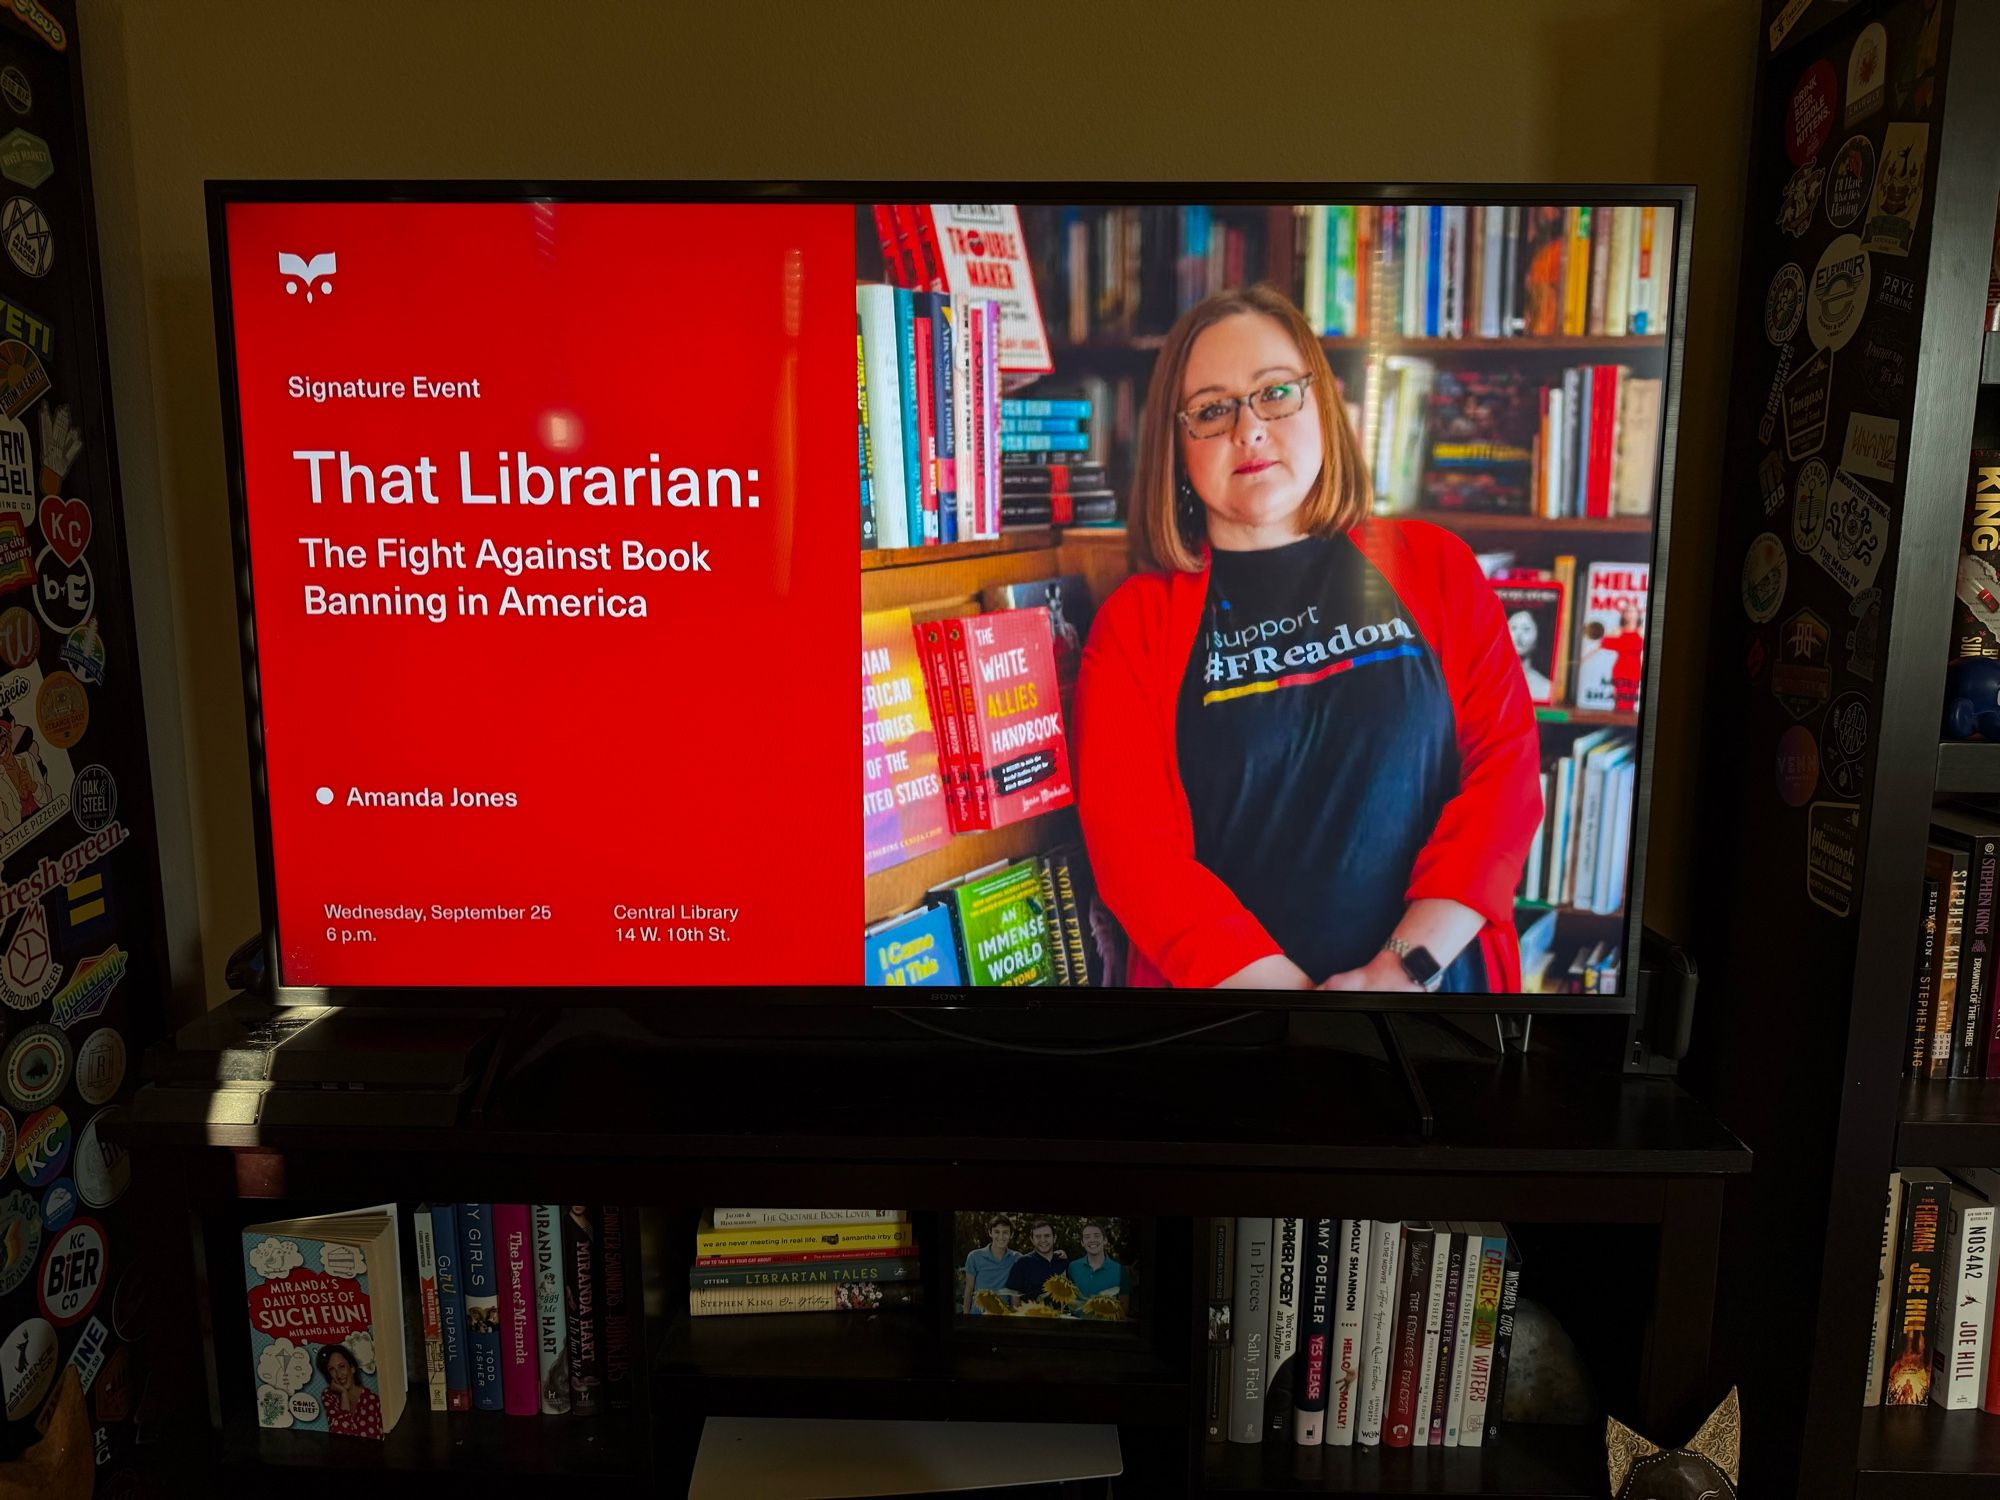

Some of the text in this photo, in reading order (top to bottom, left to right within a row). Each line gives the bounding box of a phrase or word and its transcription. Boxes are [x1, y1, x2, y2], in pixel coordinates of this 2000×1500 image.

[1794, 75, 1817, 108] DRINK
[1796, 94, 1825, 133] CUDDLE
[12, 240, 35, 265] MADER
[14, 233, 37, 257] ALMA
[966, 260, 1015, 289] MAKER
[1816, 254, 1865, 288] ELEVATOR
[289, 377, 480, 402] Signature Event
[942, 323, 955, 454] Ancestor Trouble
[975, 339, 985, 477] POWER HUNGRY
[293, 451, 759, 507] That Librarian:
[1800, 465, 1826, 488] VICTORIA
[1764, 483, 1785, 516] ZOO
[299, 538, 711, 576] The Fight Against Book
[1832, 559, 1851, 580] MARK
[305, 586, 646, 622] Banning in America
[975, 627, 995, 647] THE
[1213, 605, 1319, 648] support
[979, 648, 1029, 683] WHITE
[987, 682, 1039, 719] ALLIES
[991, 712, 1062, 755] HANDBOOK
[867, 750, 909, 780] OF THE
[83, 781, 99, 795] OAK
[83, 797, 108, 813] STEEL
[347, 787, 517, 806] Amanda Jones
[896, 774, 940, 805] STATES
[5, 799, 66, 850] STYLE PIZZERIA
[325, 905, 551, 923] Wednesday, September 25
[615, 905, 739, 923] Central Library
[1001, 907, 1017, 924] AN
[1058, 866, 1089, 986] NORA EPHRON
[1942, 870, 1968, 980] STEPHEN KING
[327, 928, 375, 945] 6 p.m.
[617, 927, 730, 941] 14 W. 10th St.
[978, 913, 1046, 962] IMMENSE
[988, 942, 1043, 982] WORLD
[1964, 858, 1996, 1047] STEPHEN KING DRAWING OF THE THREE
[42, 965, 61, 997] BEER
[57, 954, 120, 1020] BOULEVARD
[931, 993, 967, 1001] SONY
[1912, 891, 1938, 1067] ELEVATION STEPHEN KING
[20, 1113, 56, 1152] MADE IN
[26, 1128, 63, 1178] KC
[70, 1233, 85, 1249] KC
[468, 1228, 484, 1286] GIRLS
[750, 1238, 779, 1247] meeting
[841, 1234, 876, 1242] samantha
[877, 1233, 891, 1242] irby
[745, 1271, 828, 1285] LIBRARIAN
[833, 1268, 878, 1280] TALES
[1346, 1218, 1362, 1311] MOLLY SHANNON
[1903, 1204, 1939, 1336] FIREMAN JOE HILL
[62, 1293, 78, 1310] CO
[263, 1291, 355, 1309] DAILY DOSE OF
[270, 1279, 340, 1294] MIRANDA'S
[509, 1231, 528, 1365] The Best of Miranda
[576, 1240, 595, 1362] MIRANDA HART
[700, 1298, 773, 1309] STEPHEN KING
[1279, 1264, 1293, 1307] POSEY
[1430, 1253, 1445, 1327] CARRIE FISHER
[1442, 1253, 1462, 1343] CARRIE FISHER
[1462, 1254, 1478, 1327] CARRIE FISHER
[1955, 1226, 1987, 1381] NOS4A2 JOE HILL
[259, 1303, 369, 1329] SUCH FUN!
[1243, 1241, 1266, 1400] In Pieces Sally Field
[1308, 1218, 1329, 1400] AMY POEHLER YES PLEASE
[1469, 1249, 1503, 1403] CARSICK JOHN WATERS
[289, 1326, 350, 1338] MIRANDA HART
[446, 1306, 458, 1361] RUPAUL
[542, 1316, 557, 1355] HART
[1273, 1323, 1284, 1360] Airplane
[1284, 1336, 1291, 1351] on
[475, 1343, 485, 1387] FISHER
[486, 1349, 496, 1382] TODD
[1341, 1338, 1352, 1369] HELLO
